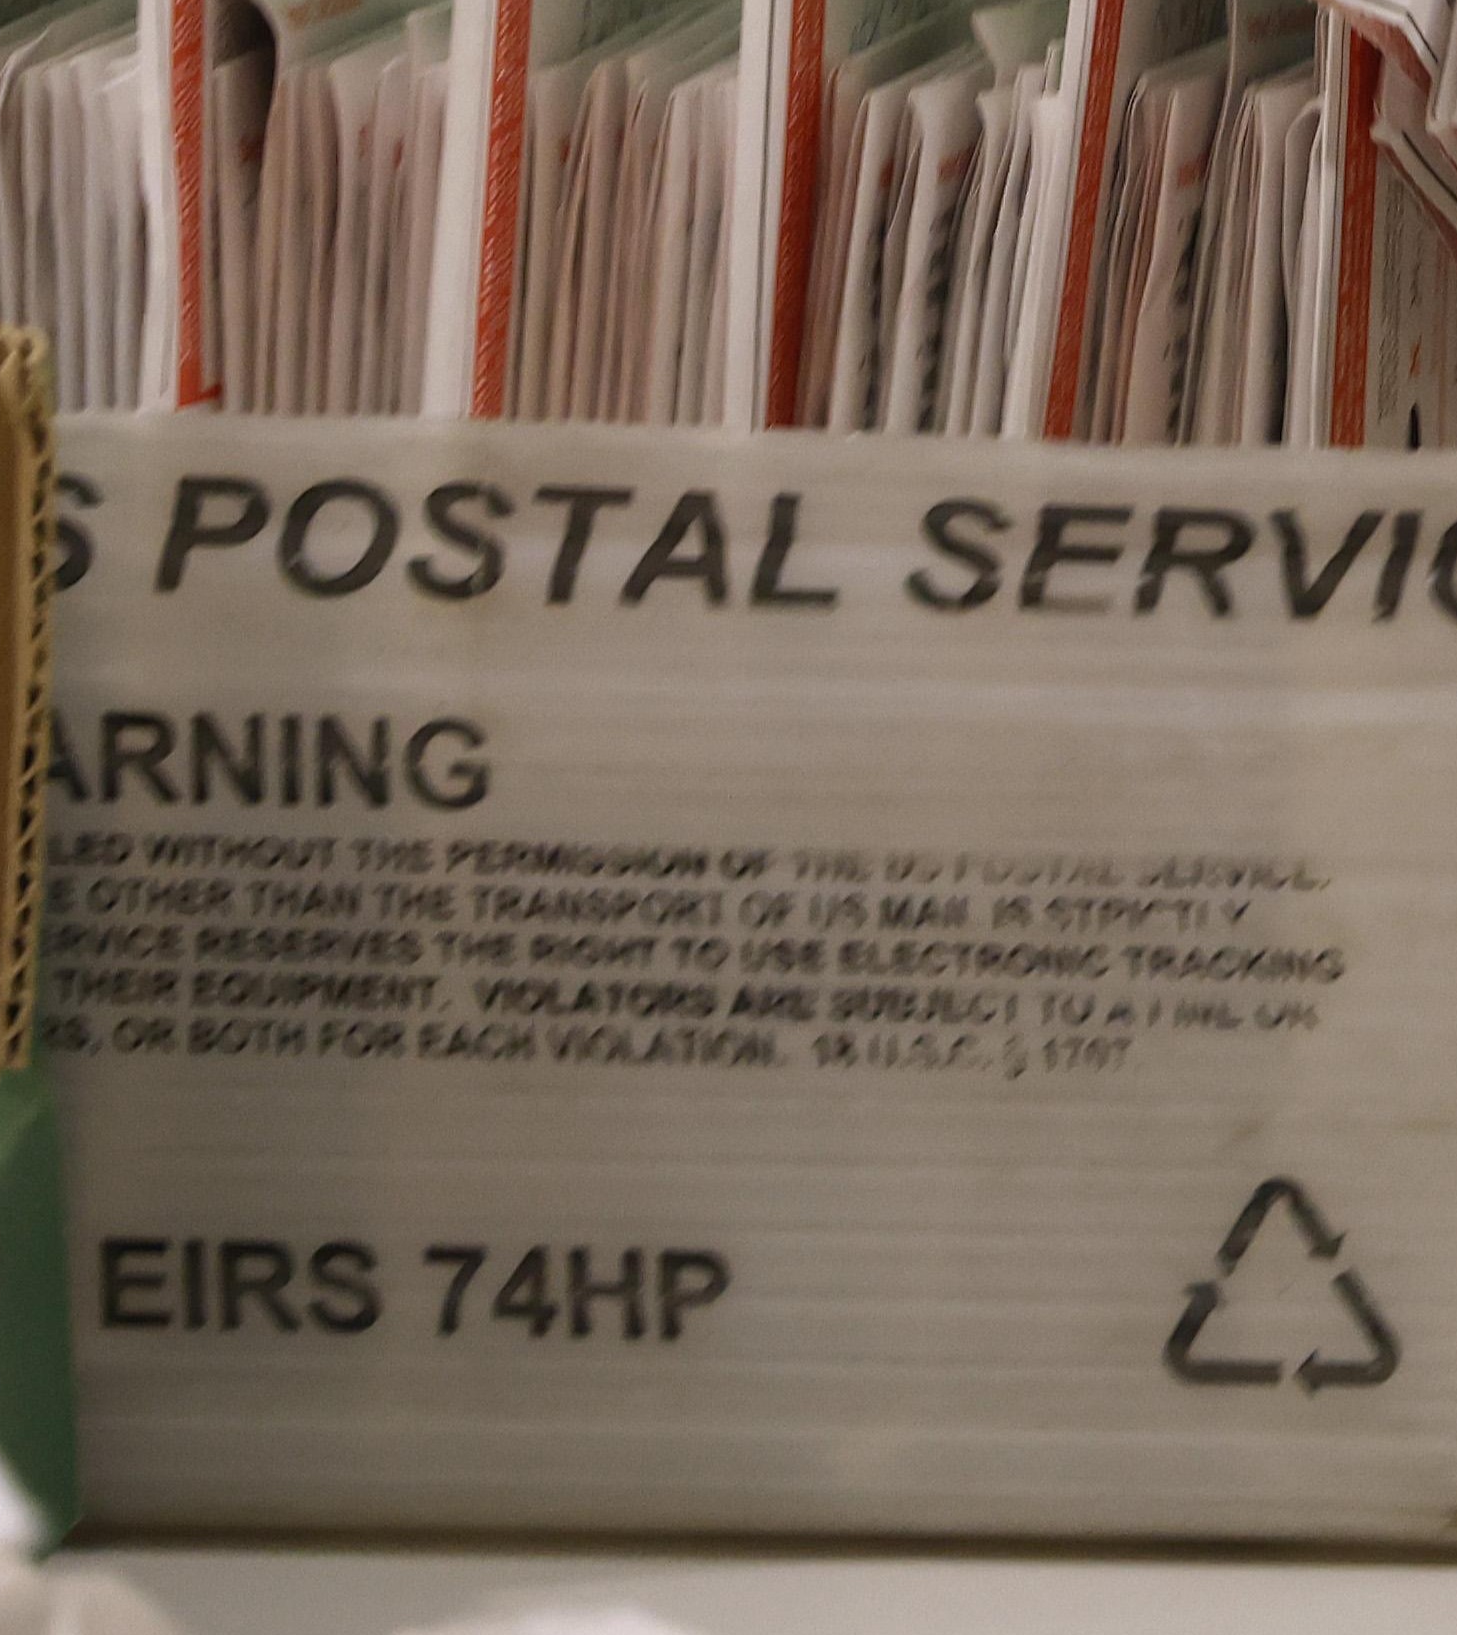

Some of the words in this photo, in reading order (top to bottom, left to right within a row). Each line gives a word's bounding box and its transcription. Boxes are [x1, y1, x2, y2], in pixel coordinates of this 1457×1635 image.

[154, 476, 841, 608] POSTAL
[145, 833, 338, 867] WITHOUT
[348, 837, 434, 873] THE
[446, 839, 708, 877] PERMISSION
[86, 876, 236, 916] OTHER
[246, 880, 363, 917] THAN
[373, 883, 456, 921] THE
[473, 884, 724, 926] TRANSPORT
[737, 890, 799, 929] OF
[194, 927, 424, 965] RESERVES
[432, 929, 516, 964] THE
[529, 933, 661, 965] RIGHT
[671, 935, 730, 968] TO
[740, 938, 826, 972] USE
[836, 940, 1111, 978] ELECTRONIC
[1119, 945, 1346, 984] TRACKING
[52, 966, 181, 1005] THEIR
[474, 977, 720, 1017] VIOLATORS
[726, 984, 820, 1021] ARE
[111, 1017, 176, 1054] OR
[187, 1017, 308, 1055] BOTH
[316, 1019, 406, 1057] FOR
[418, 1023, 538, 1059] EACH
[99, 1238, 384, 1336] EIRS
[423, 1242, 734, 1341] 74HP
